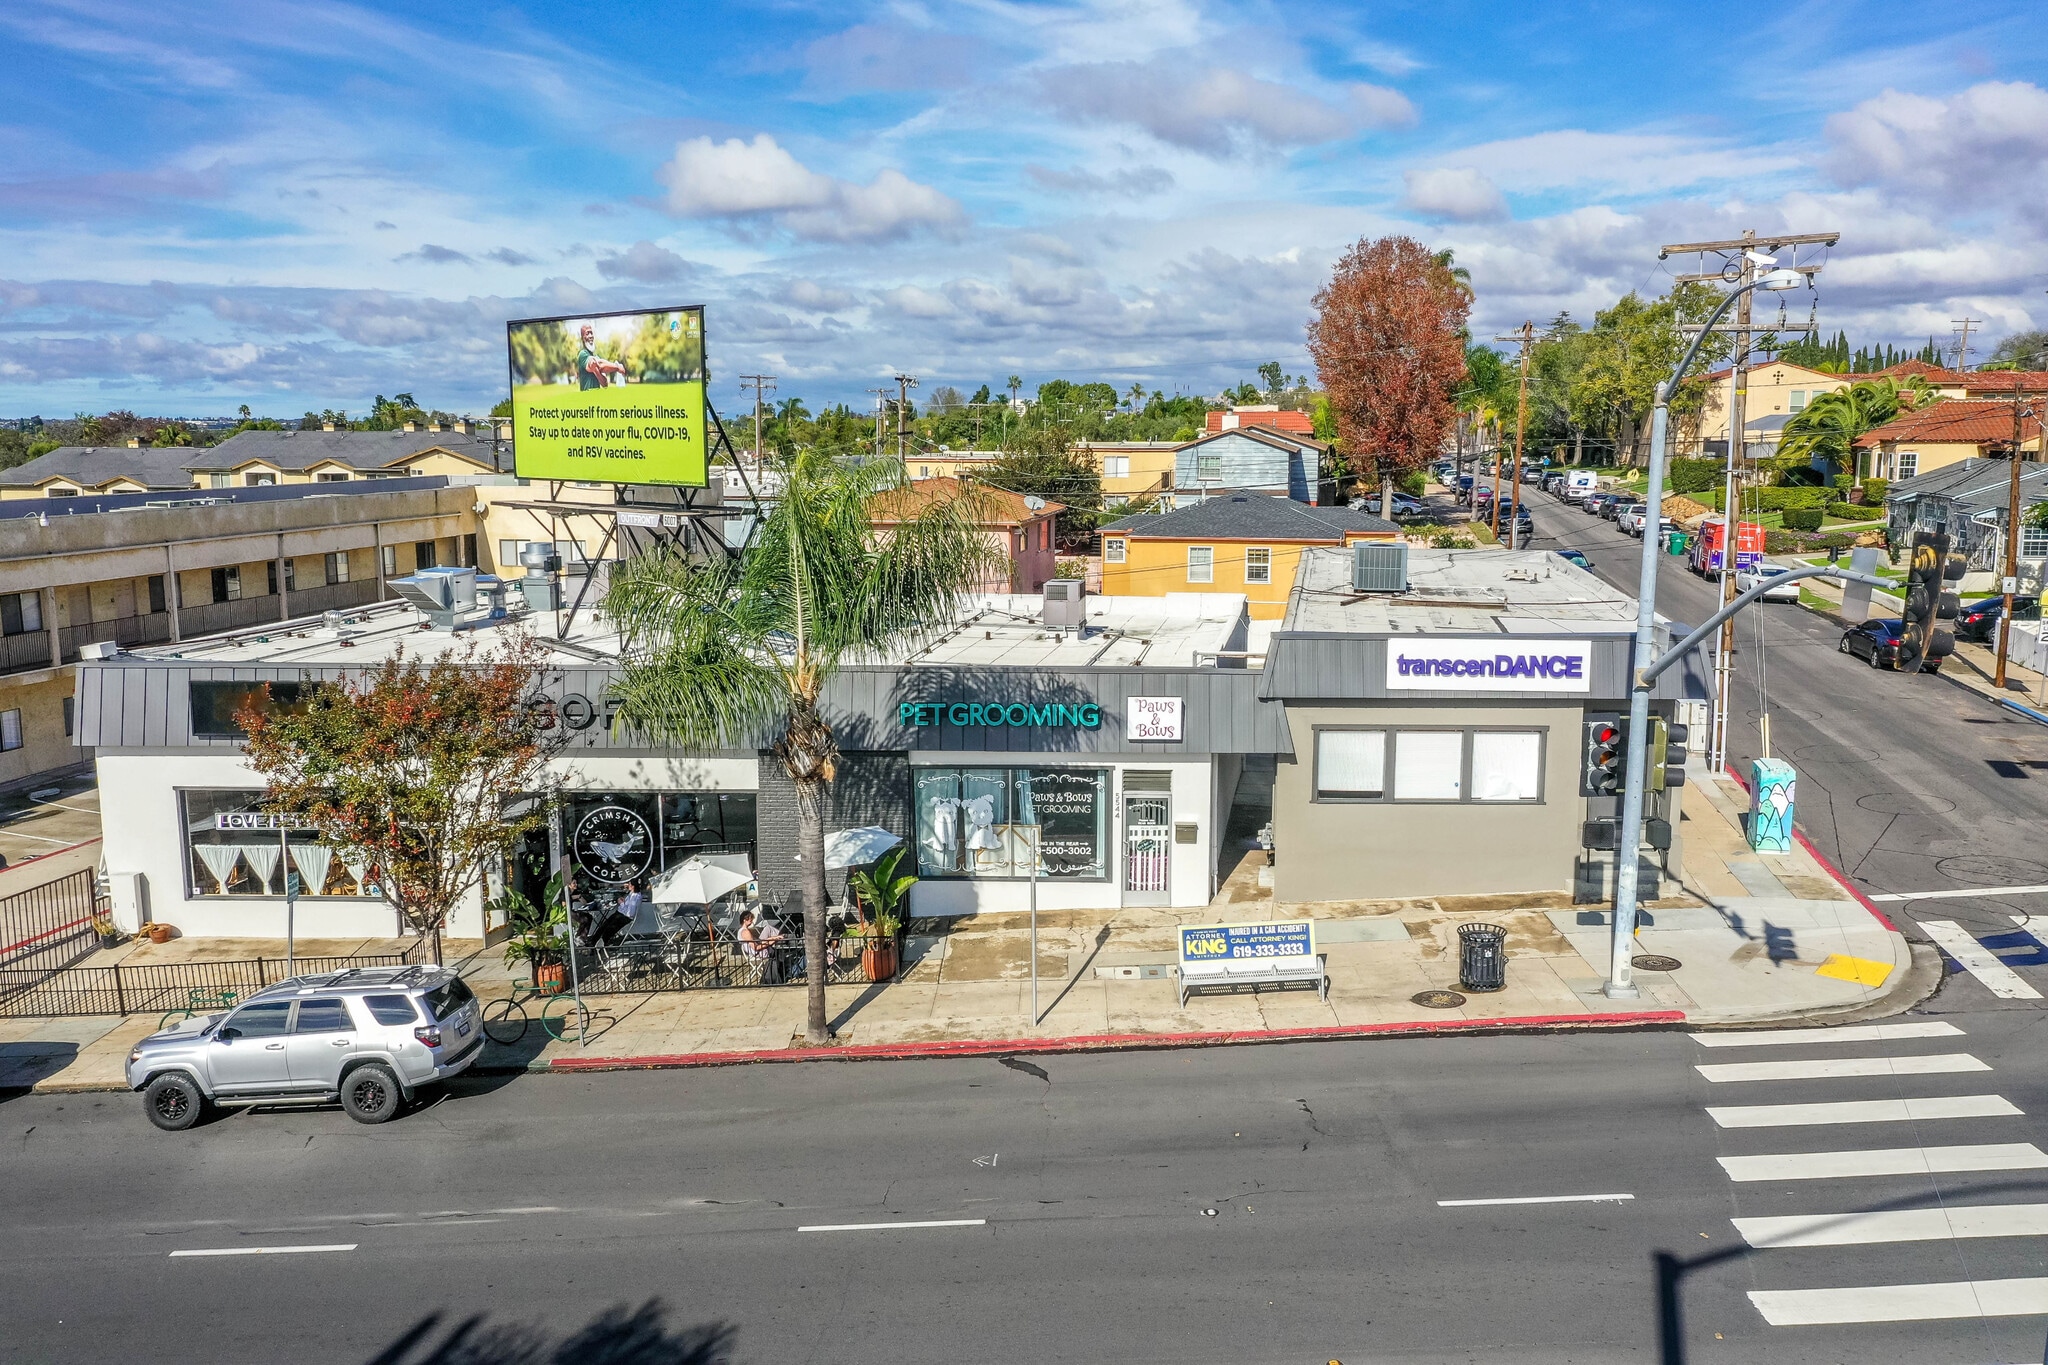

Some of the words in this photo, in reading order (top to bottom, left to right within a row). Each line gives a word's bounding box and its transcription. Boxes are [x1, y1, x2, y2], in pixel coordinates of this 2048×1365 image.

[529, 407, 559, 419] Protect
[561, 406, 595, 421] yourself
[596, 406, 618, 419] from
[620, 405, 653, 419] serious
[655, 405, 688, 419] illness.
[529, 426, 546, 440] Stay
[548, 428, 559, 440] up
[561, 427, 570, 438] to
[571, 426, 590, 438] date
[592, 428, 603, 438] on
[605, 428, 625, 441] your
[627, 426, 642, 442] flu,
[644, 426, 690, 442] COVID-19,
[567, 445, 584, 458] and
[585, 446, 602, 458] RSV
[604, 445, 646, 460] vaccines.
[620, 514, 655, 526] OUTFRONT
[1397, 654, 1583, 679] transcenDANCE
[1135, 698, 1175, 714] Paws
[900, 703, 946, 727] PET
[948, 702, 1099, 727] GROOMING
[1151, 712, 1160, 726] &
[1135, 723, 1175, 738] Bows
[1056, 792, 1063, 803] &
[1064, 792, 1093, 803] Bows
[1042, 804, 1091, 813] GROOMING
[581, 811, 645, 836] SCRIMSHAW
[593, 863, 639, 879] COFFEE
[749, 883, 756, 891] A
[1185, 932, 1226, 940] ATTORNEY
[1228, 926, 1251, 936] INJURED
[1251, 926, 1258, 935] IN
[1259, 926, 1264, 934] A
[1264, 925, 1276, 934] CAR
[1277, 924, 1306, 933] ACCIDENT?
[1249, 935, 1286, 943] ATTORNEY
[1233, 942, 1304, 958] 619-333-3333
